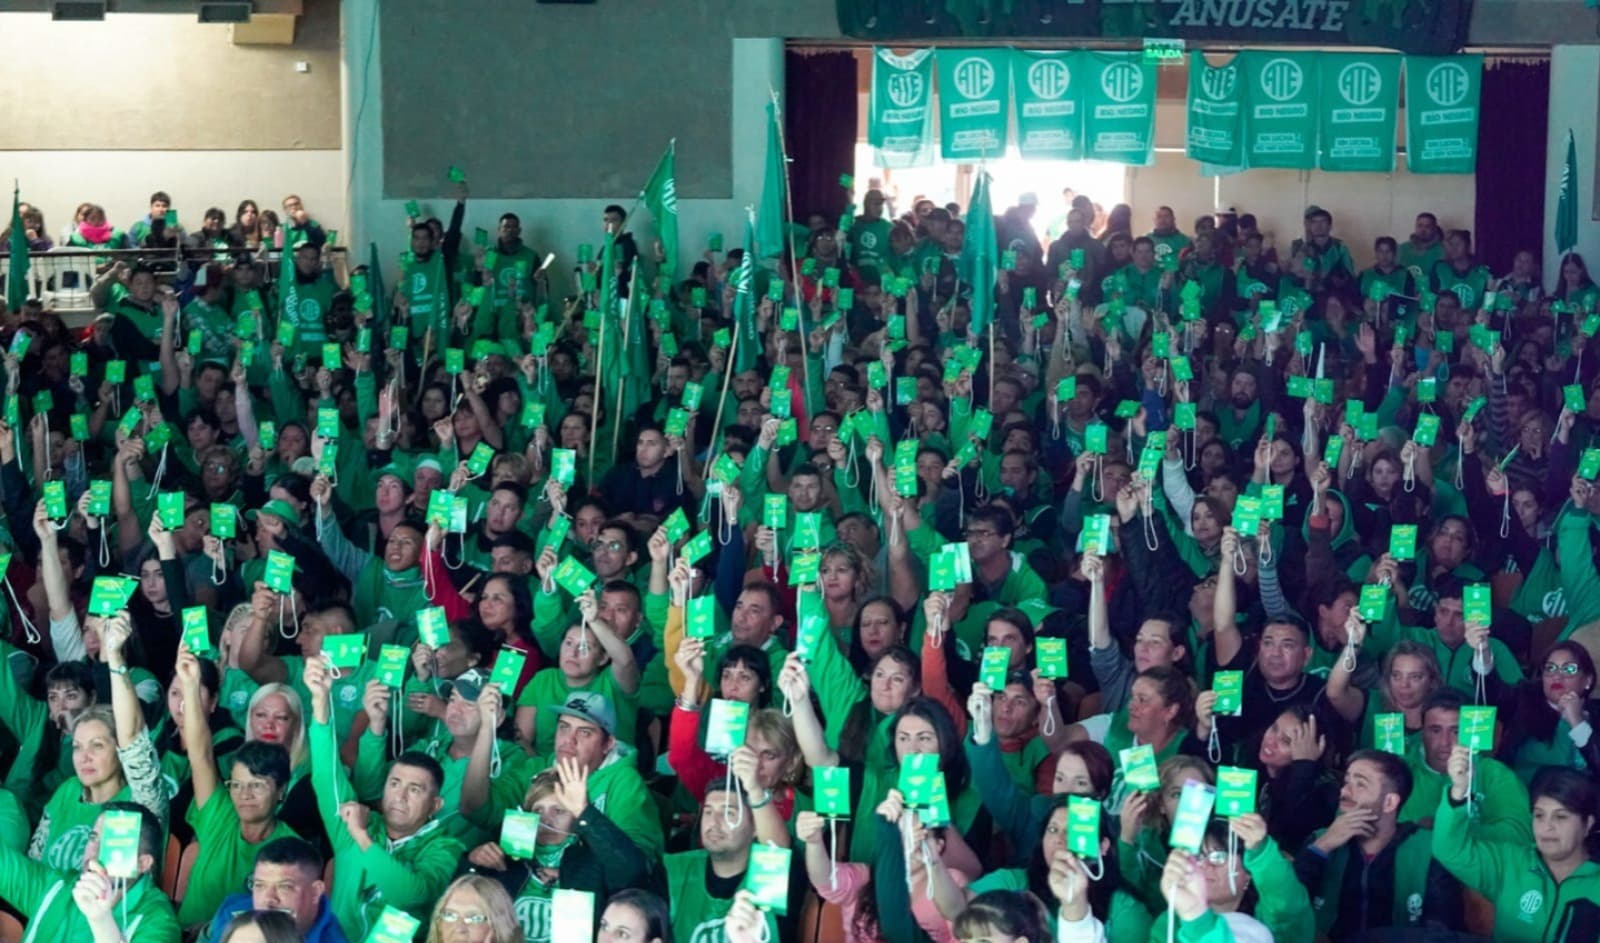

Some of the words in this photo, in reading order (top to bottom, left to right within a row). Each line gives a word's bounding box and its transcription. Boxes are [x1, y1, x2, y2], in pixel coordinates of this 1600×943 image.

[1169, 0, 1348, 31] ANUSATE
[1261, 58, 1303, 101] ATE
[1338, 62, 1382, 105] ATE
[1426, 62, 1470, 106] ATE
